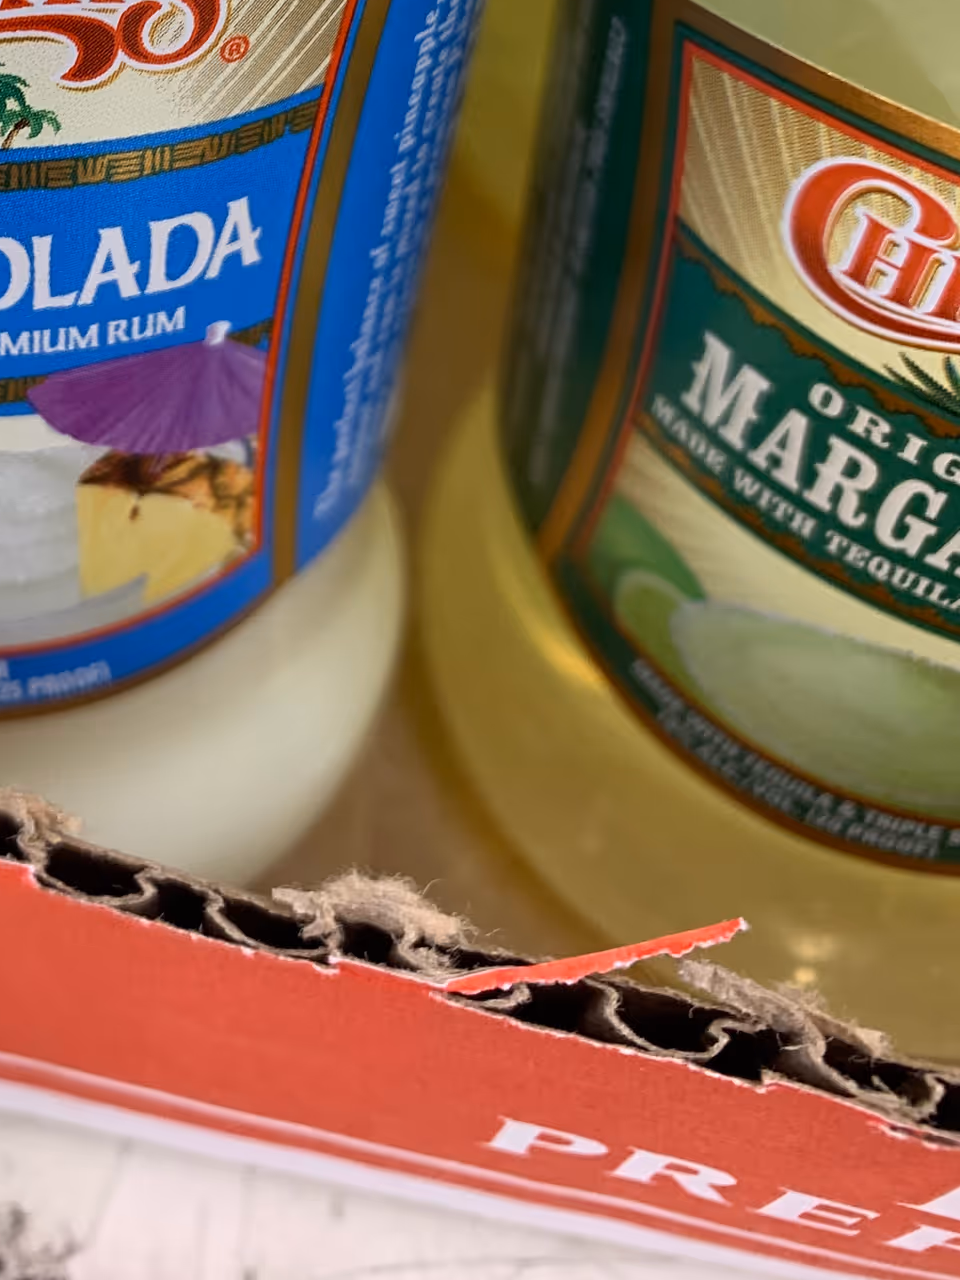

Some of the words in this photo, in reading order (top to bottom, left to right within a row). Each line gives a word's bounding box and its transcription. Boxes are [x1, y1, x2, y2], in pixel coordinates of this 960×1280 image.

[105, 305, 187, 346] RUM
[652, 392, 728, 475] MADE
[731, 468, 819, 540] WITH
[808, 382, 960, 486] ORIG
